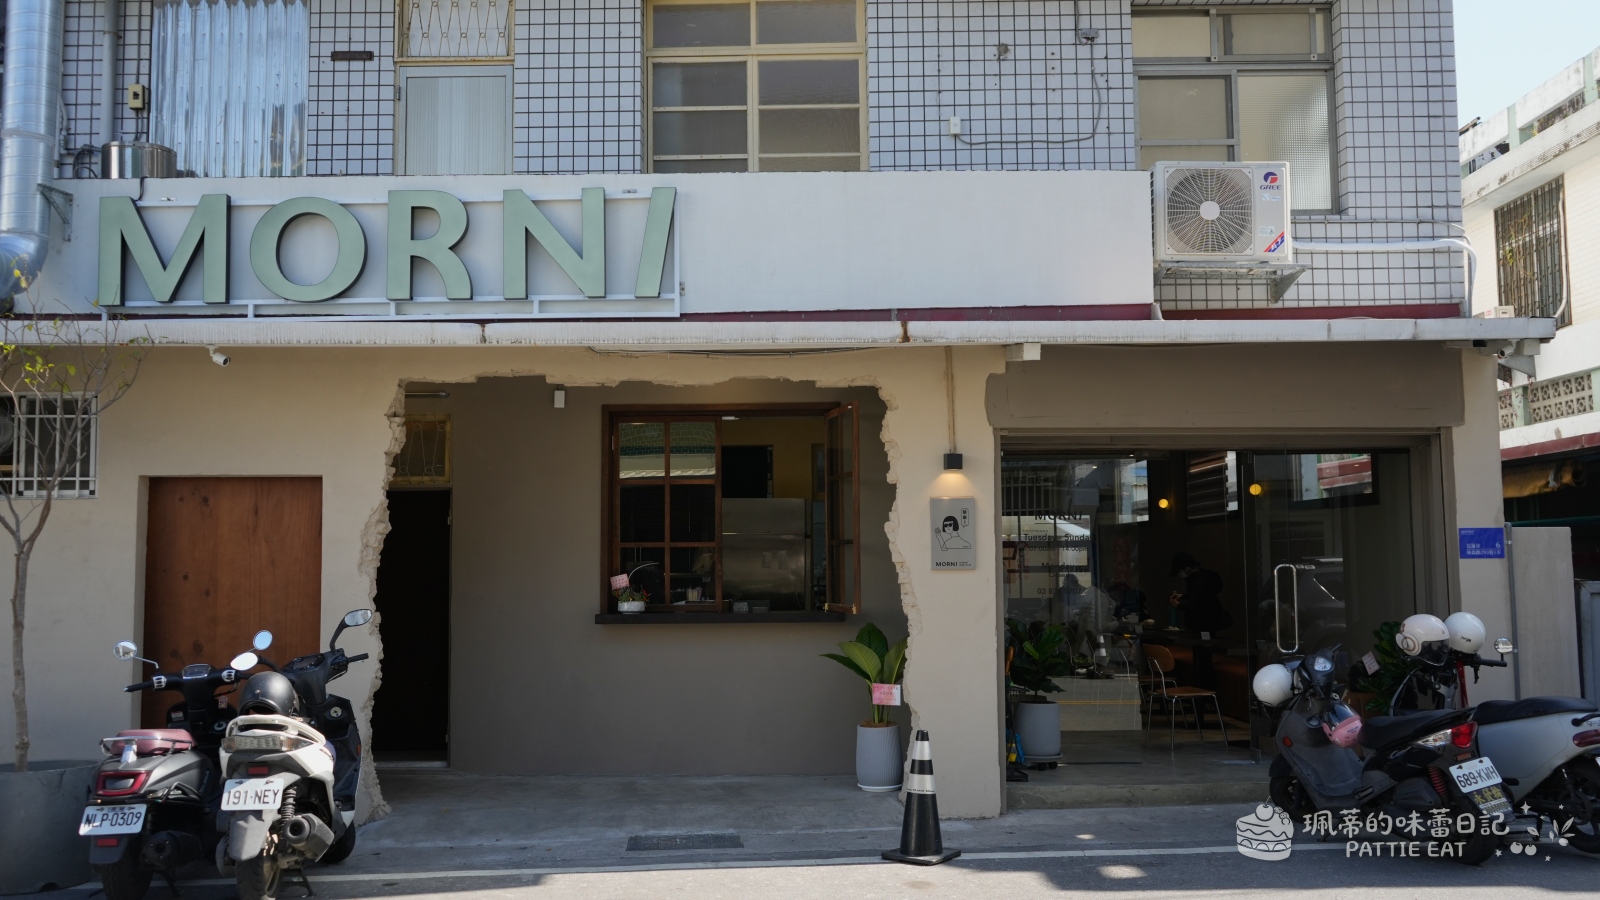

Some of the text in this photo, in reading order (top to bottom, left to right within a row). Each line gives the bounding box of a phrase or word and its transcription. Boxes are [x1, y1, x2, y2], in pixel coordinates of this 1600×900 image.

[98, 186, 677, 307] MORNI
[1024, 533, 1056, 543] Tuesday
[1495, 541, 1501, 549] 6
[1456, 765, 1499, 788] 689-KWH
[226, 788, 281, 806] 191-NEY
[83, 811, 143, 828] NLP-0309
